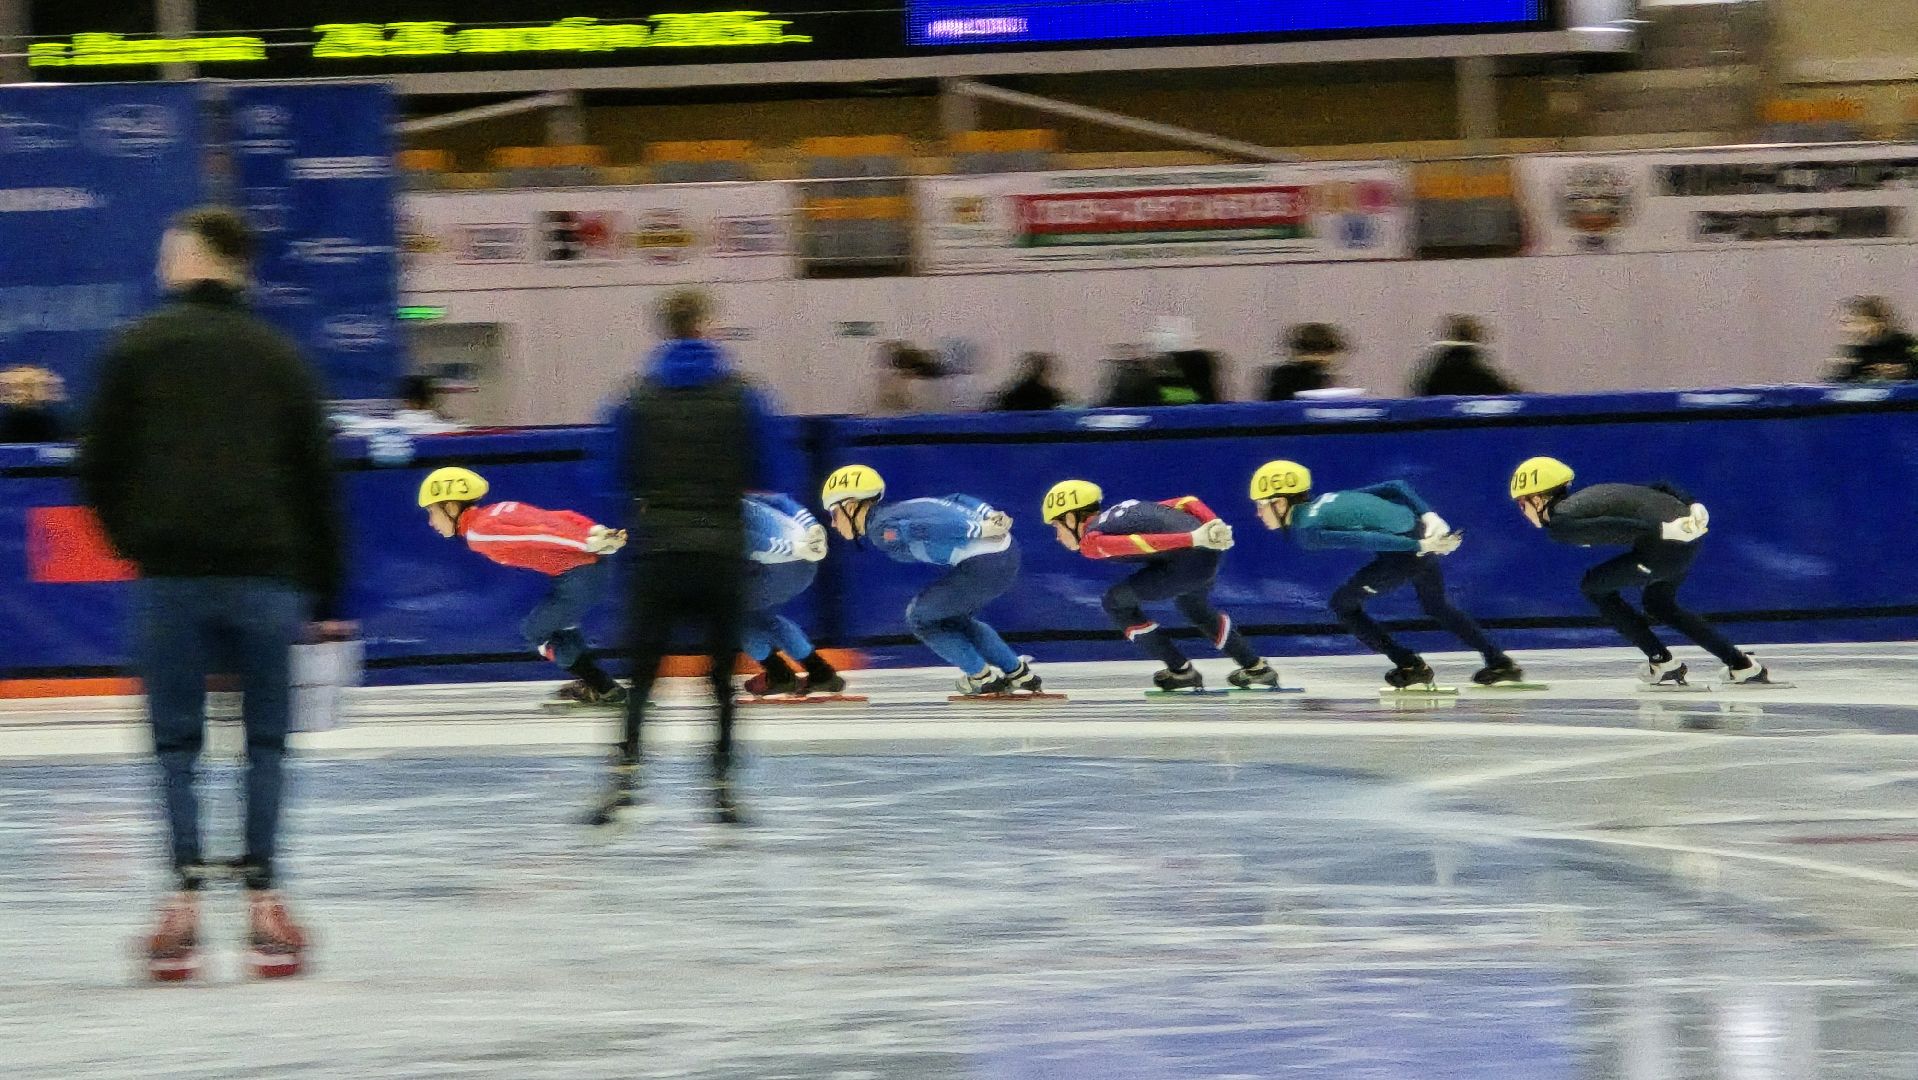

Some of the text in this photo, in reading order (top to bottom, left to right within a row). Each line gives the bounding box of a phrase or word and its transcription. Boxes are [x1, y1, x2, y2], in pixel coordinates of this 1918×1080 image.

[430, 478, 470, 496] 073
[828, 471, 862, 490] 047
[1258, 471, 1299, 492] 060
[1047, 490, 1079, 508] 081
